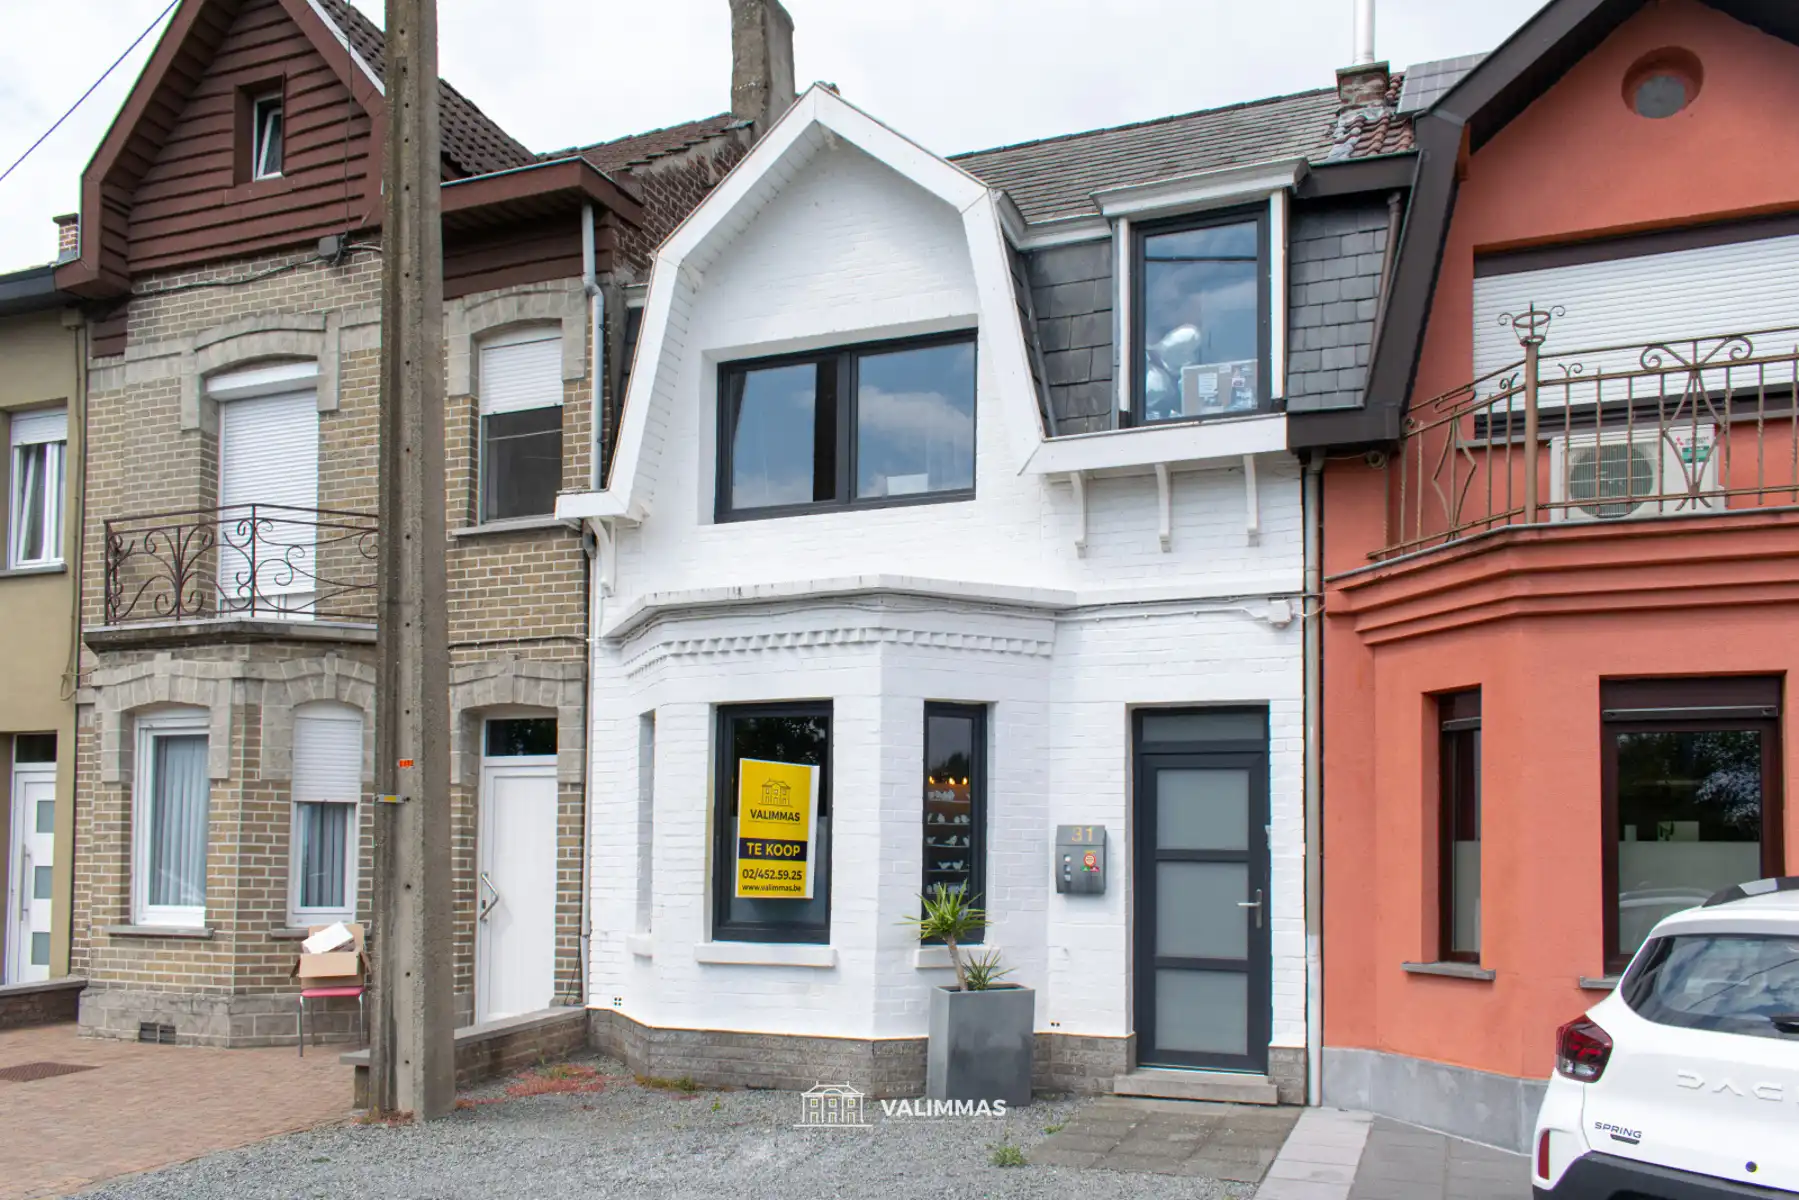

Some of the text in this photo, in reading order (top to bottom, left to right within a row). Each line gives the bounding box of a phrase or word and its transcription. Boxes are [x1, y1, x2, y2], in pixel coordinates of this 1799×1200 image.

[750, 809, 801, 822] VALIMMAS
[1072, 826, 1093, 842] 31
[746, 842, 801, 857] TE KOOP
[742, 868, 803, 880] 02/452.59.25
[742, 884, 802, 892] www.valimmas.be
[1676, 1068, 1799, 1104] DAC
[1593, 1121, 1642, 1139] SPRING
